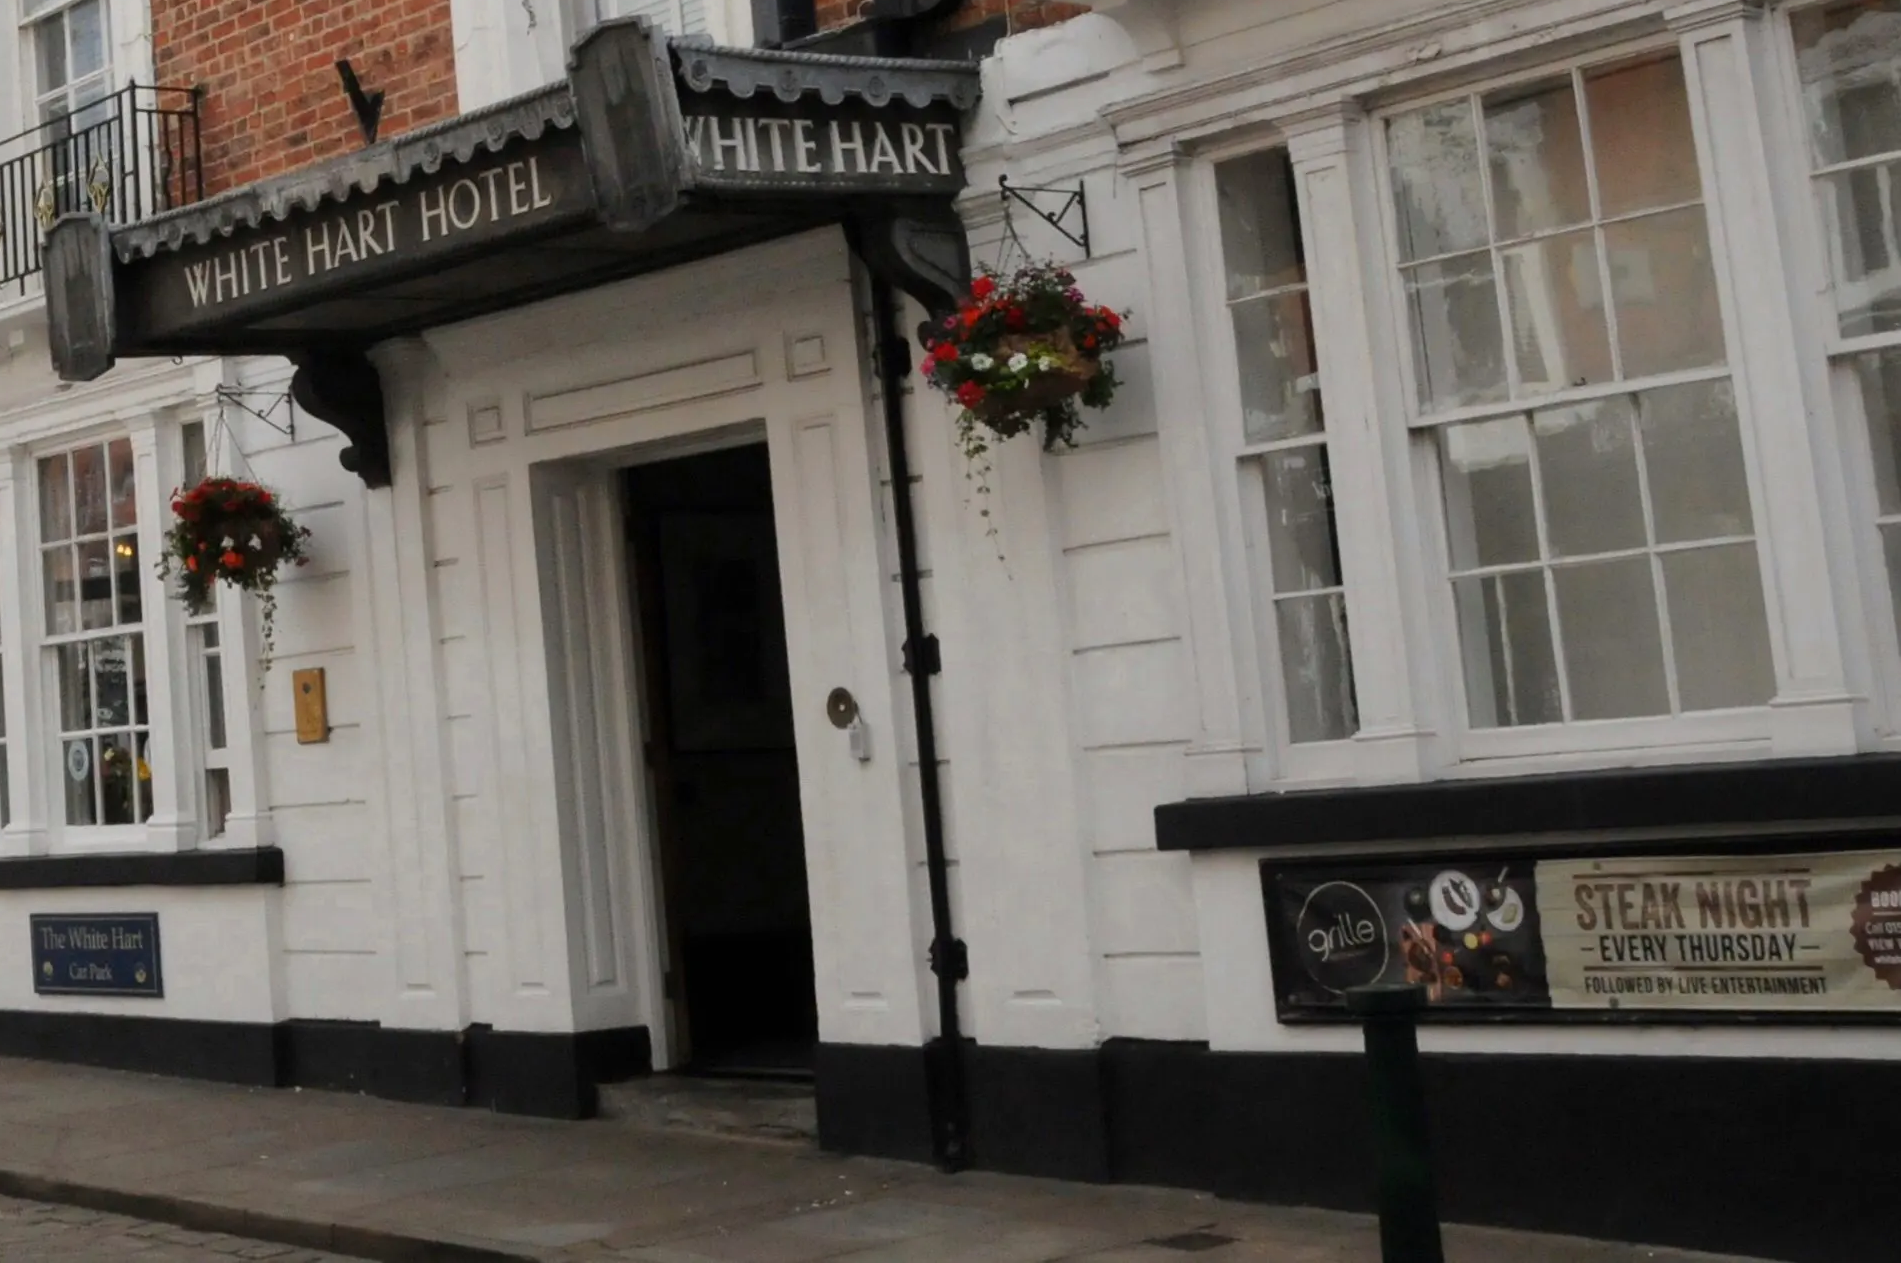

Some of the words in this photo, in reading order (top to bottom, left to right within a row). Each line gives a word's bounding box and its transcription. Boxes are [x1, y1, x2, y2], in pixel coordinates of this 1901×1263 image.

[829, 119, 955, 175] HART
[184, 236, 292, 308] WHITE
[305, 200, 399, 275] HART
[419, 156, 552, 241] HOTEL
[1573, 881, 1686, 931] STEAK
[1695, 878, 1812, 929] NIGHT
[39, 925, 66, 949] The
[68, 925, 109, 949] White
[111, 926, 144, 950] Hart
[1308, 912, 1375, 962] grille
[1599, 935, 1667, 962] EVERY
[1673, 933, 1797, 962] THURSDAY
[68, 962, 88, 980] Car
[89, 962, 113, 981] Park
[1584, 976, 1653, 995] FOLLOWED
[1657, 976, 1674, 995] BY
[1678, 976, 1708, 995] LIVE
[1710, 975, 1828, 996] ENTERTAINMENT
